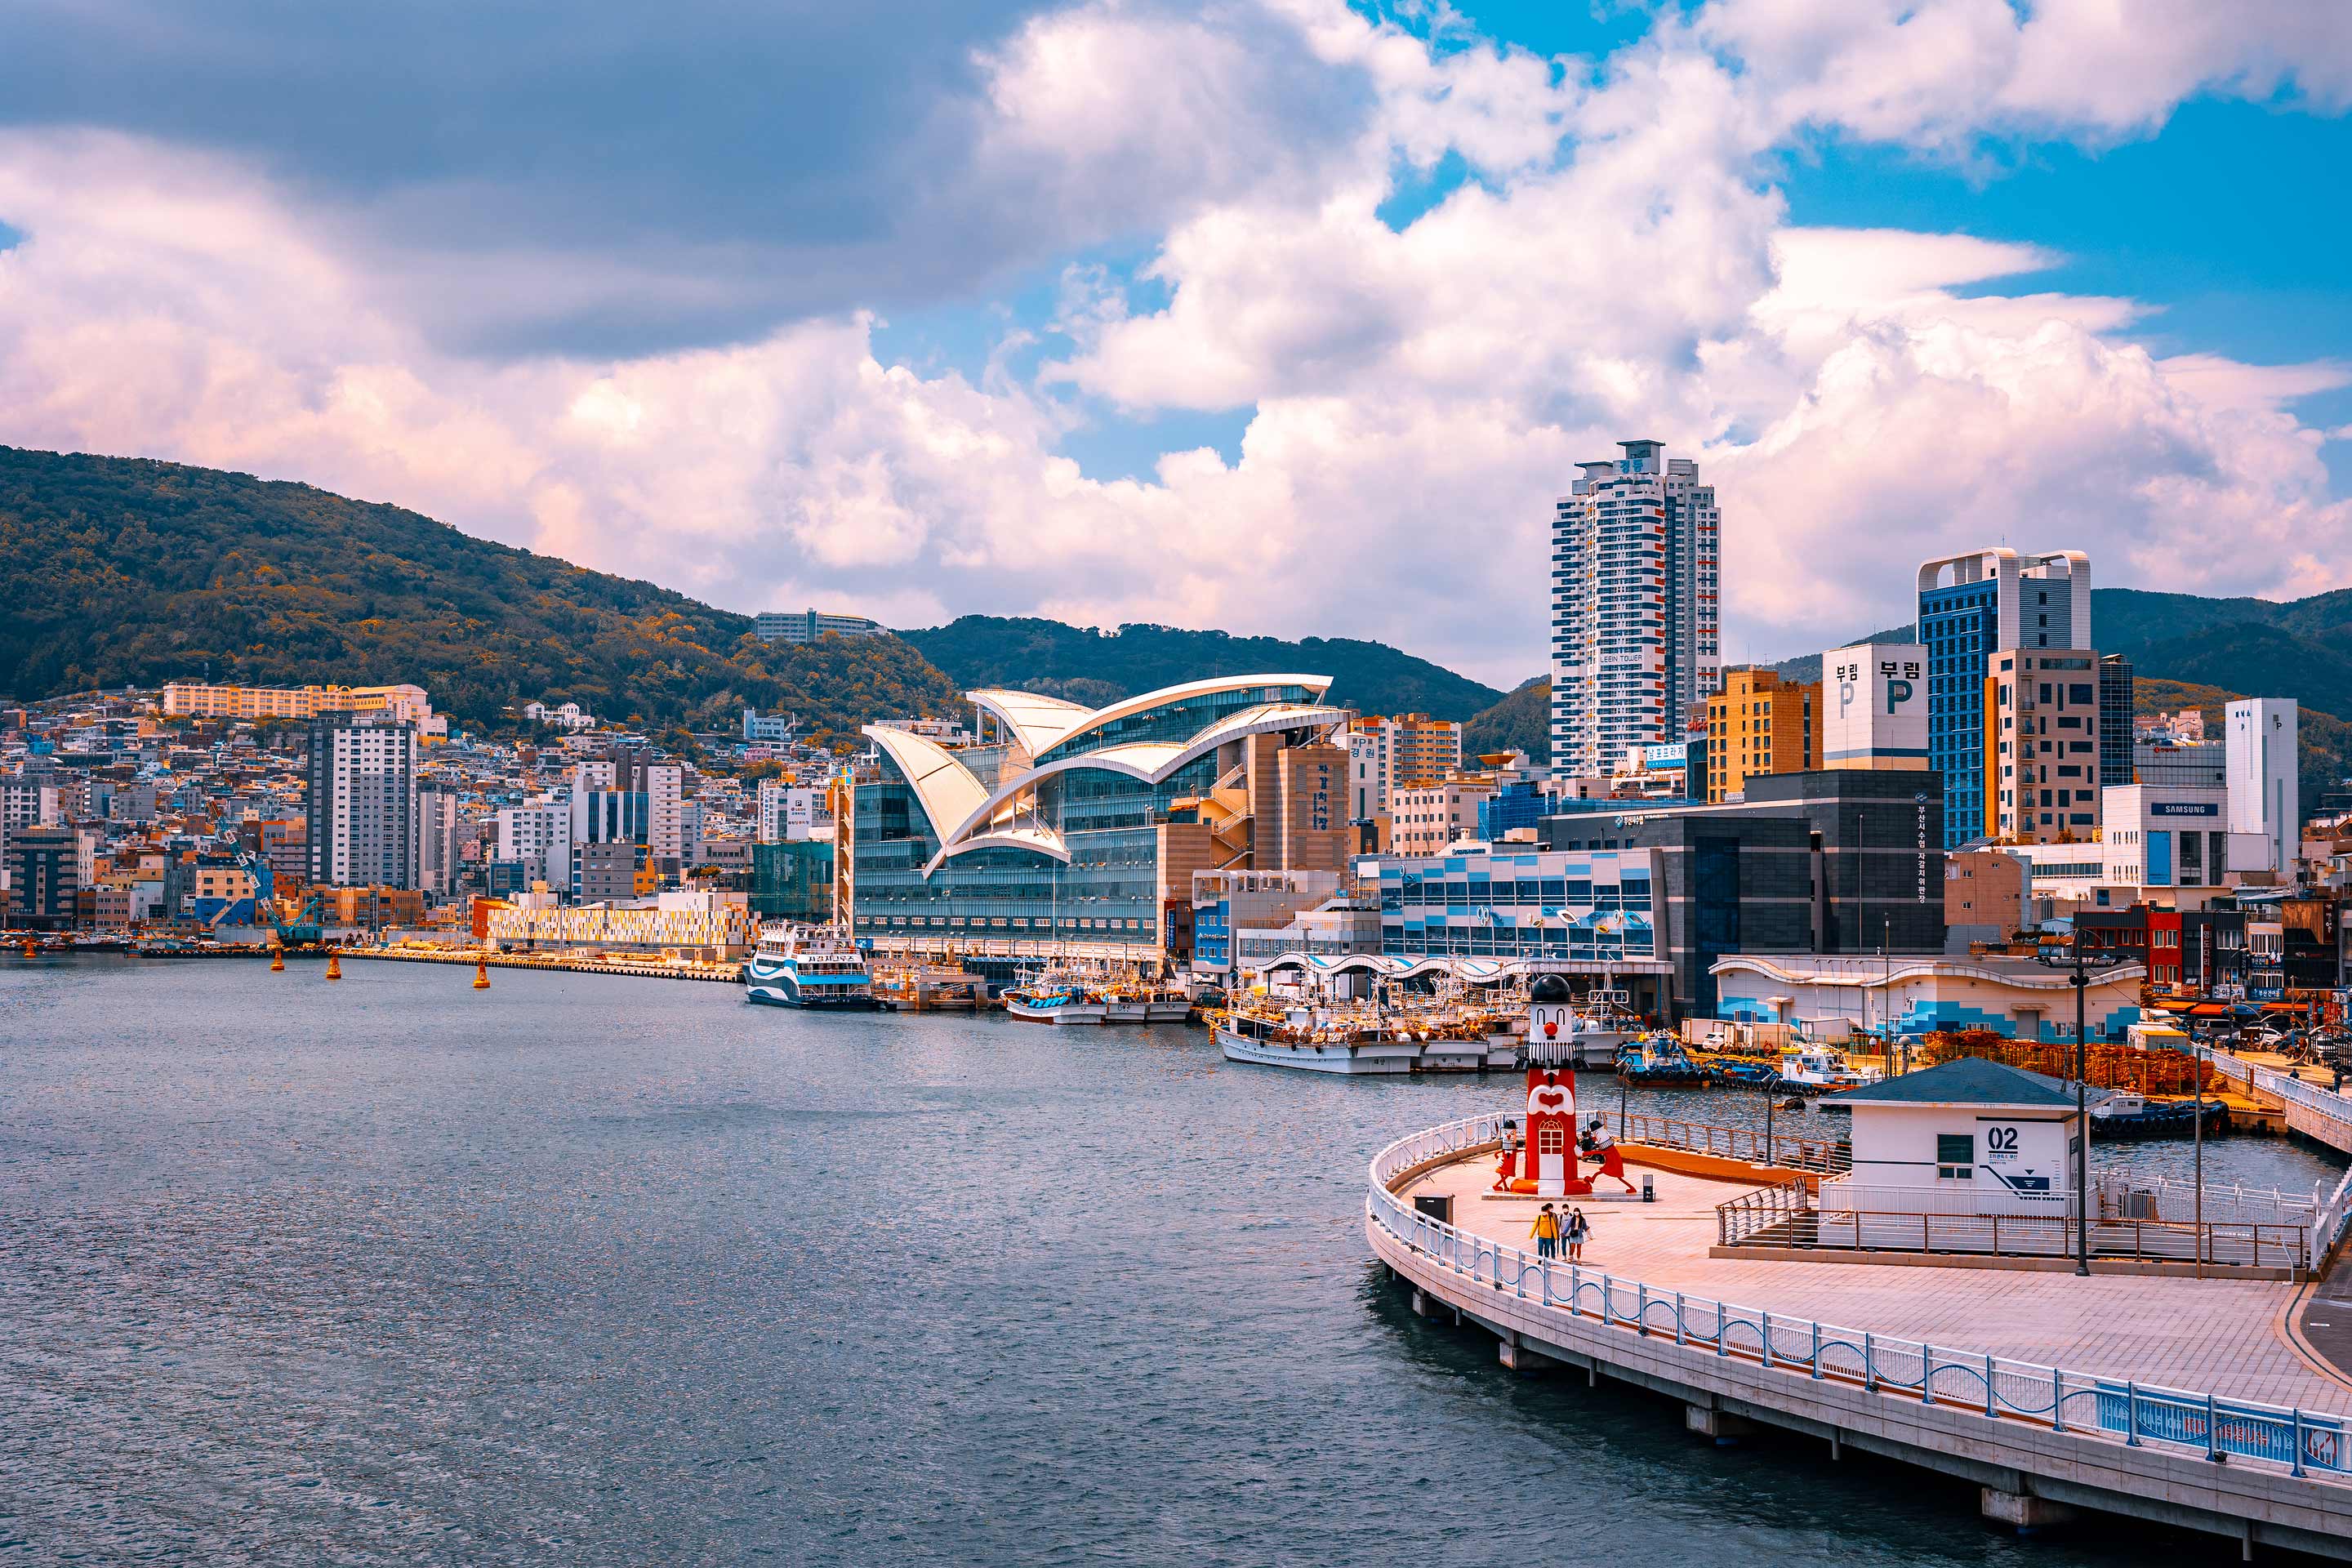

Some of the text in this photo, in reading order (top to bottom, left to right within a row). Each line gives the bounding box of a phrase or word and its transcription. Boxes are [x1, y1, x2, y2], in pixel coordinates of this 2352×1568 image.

[1837, 663, 1858, 683] 부림
[1880, 661, 1920, 679] 부림
[1840, 682, 1855, 719] P
[1887, 679, 1913, 715] P
[2276, 722, 2283, 730] P
[1359, 738, 1366, 748] P
[1351, 747, 1374, 759] 경원
[1648, 746, 1684, 760] 남포프라자
[1317, 764, 1329, 831] 자갈치시장
[2165, 805, 2205, 813] SAMSUNG
[1918, 805, 1927, 904] 부산시수협 자갈치위판장
[1988, 1127, 2018, 1150] 02
